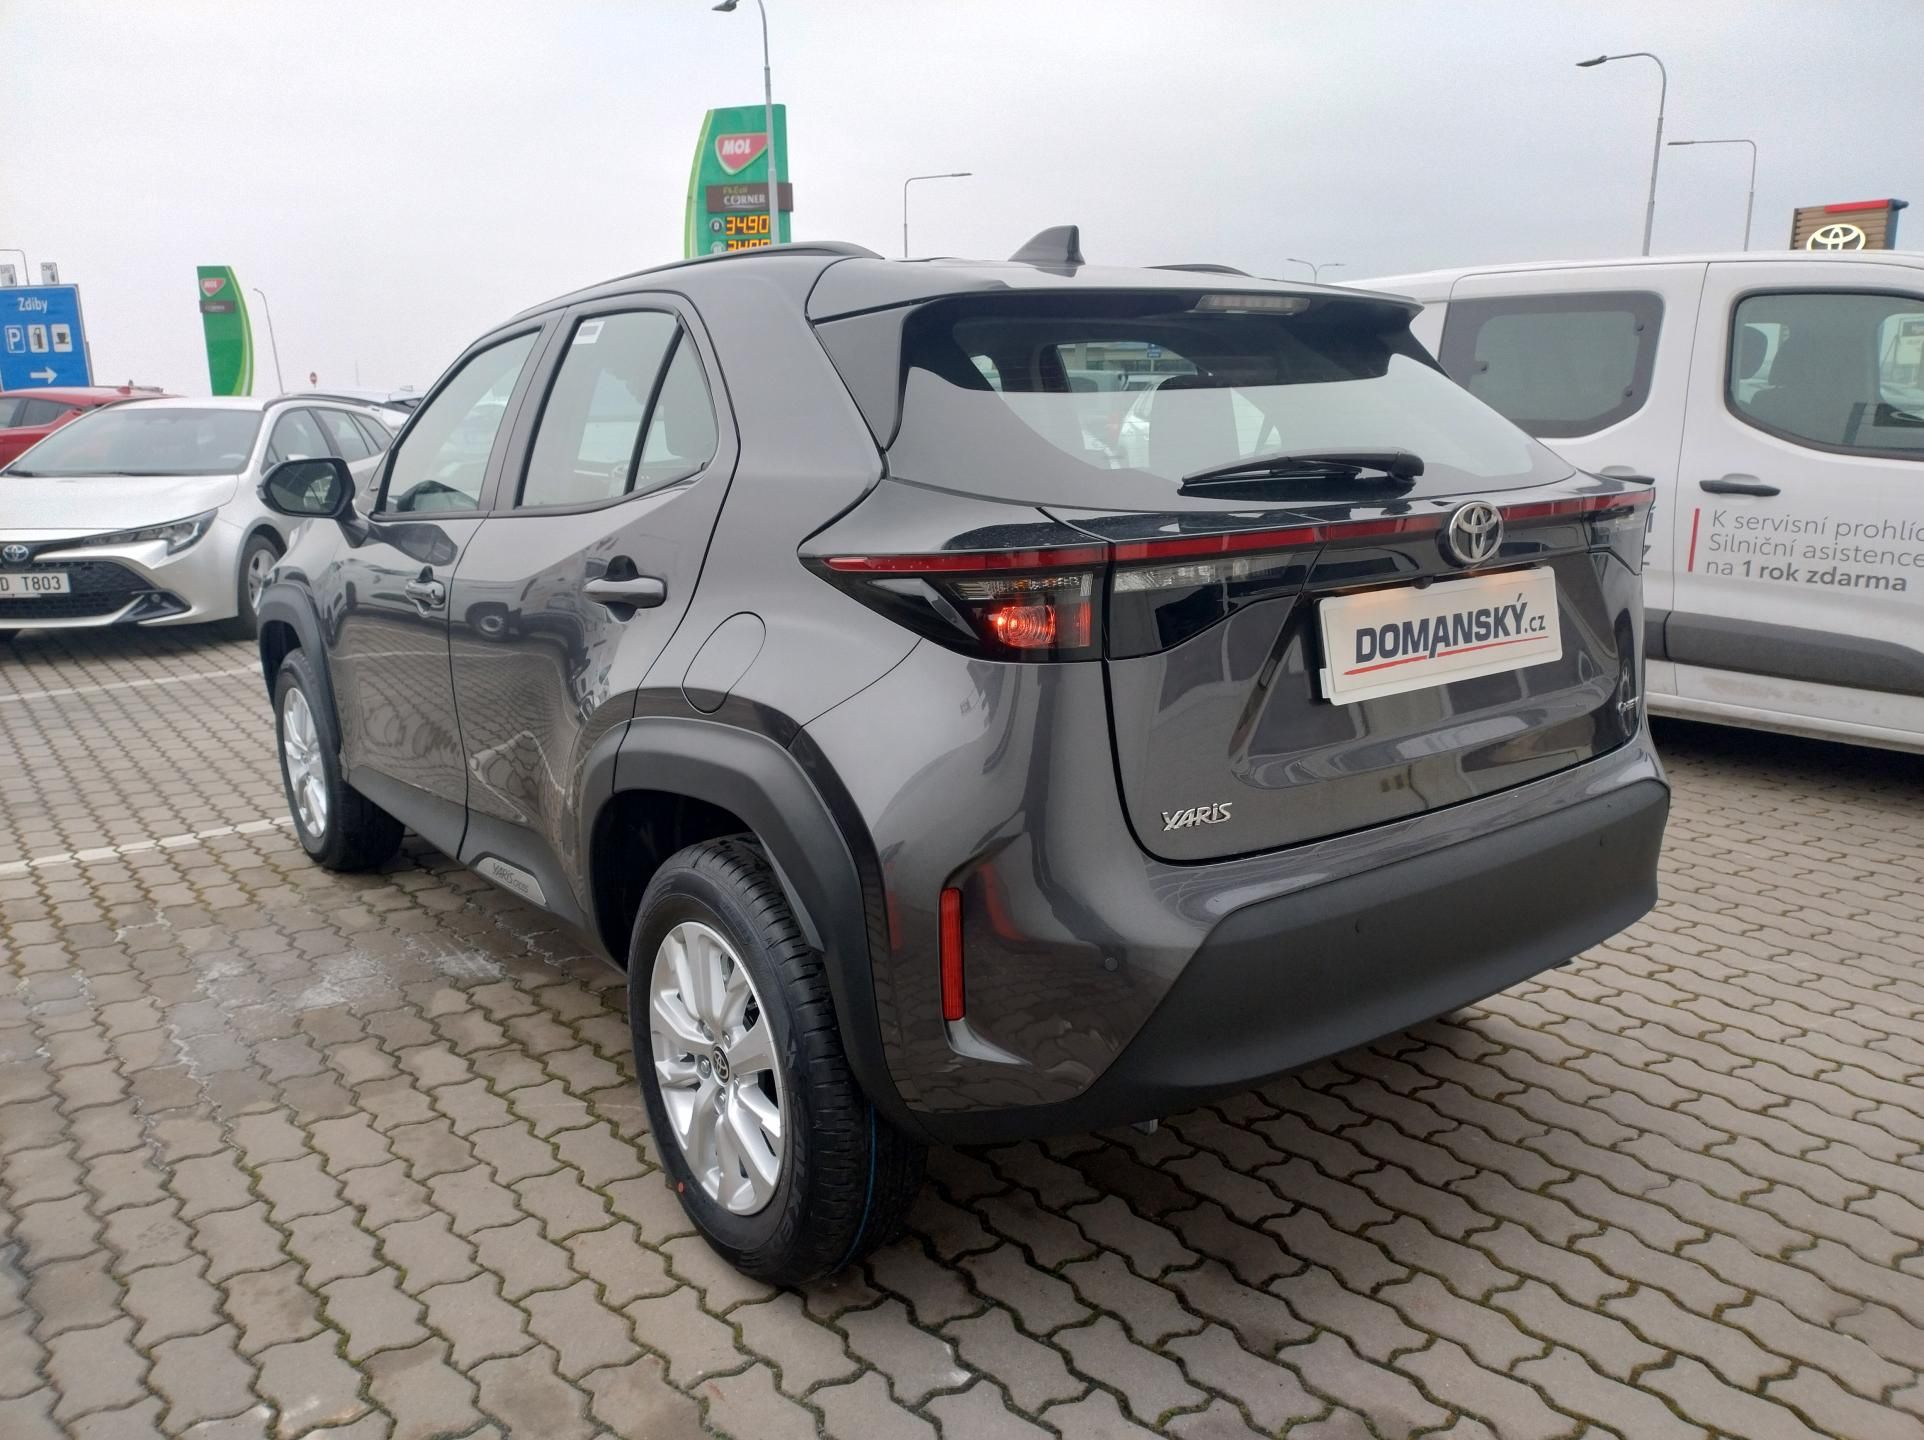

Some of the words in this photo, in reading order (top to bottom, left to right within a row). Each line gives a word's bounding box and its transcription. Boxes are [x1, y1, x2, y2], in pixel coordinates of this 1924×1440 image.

[721, 139, 752, 155] MOL
[723, 193, 766, 206] CORNER
[17, 297, 48, 314] Zdiby
[8, 328, 21, 350] P
[1712, 509, 1727, 528] K
[1734, 513, 1829, 535] servisní
[1708, 532, 1798, 557] Silniční
[1802, 541, 1924, 568] asistence
[20, 576, 61, 591] T803
[1706, 561, 1734, 576] na
[1742, 560, 1752, 577] 1
[1759, 562, 1799, 582] rok
[1805, 566, 1907, 592] zdarma
